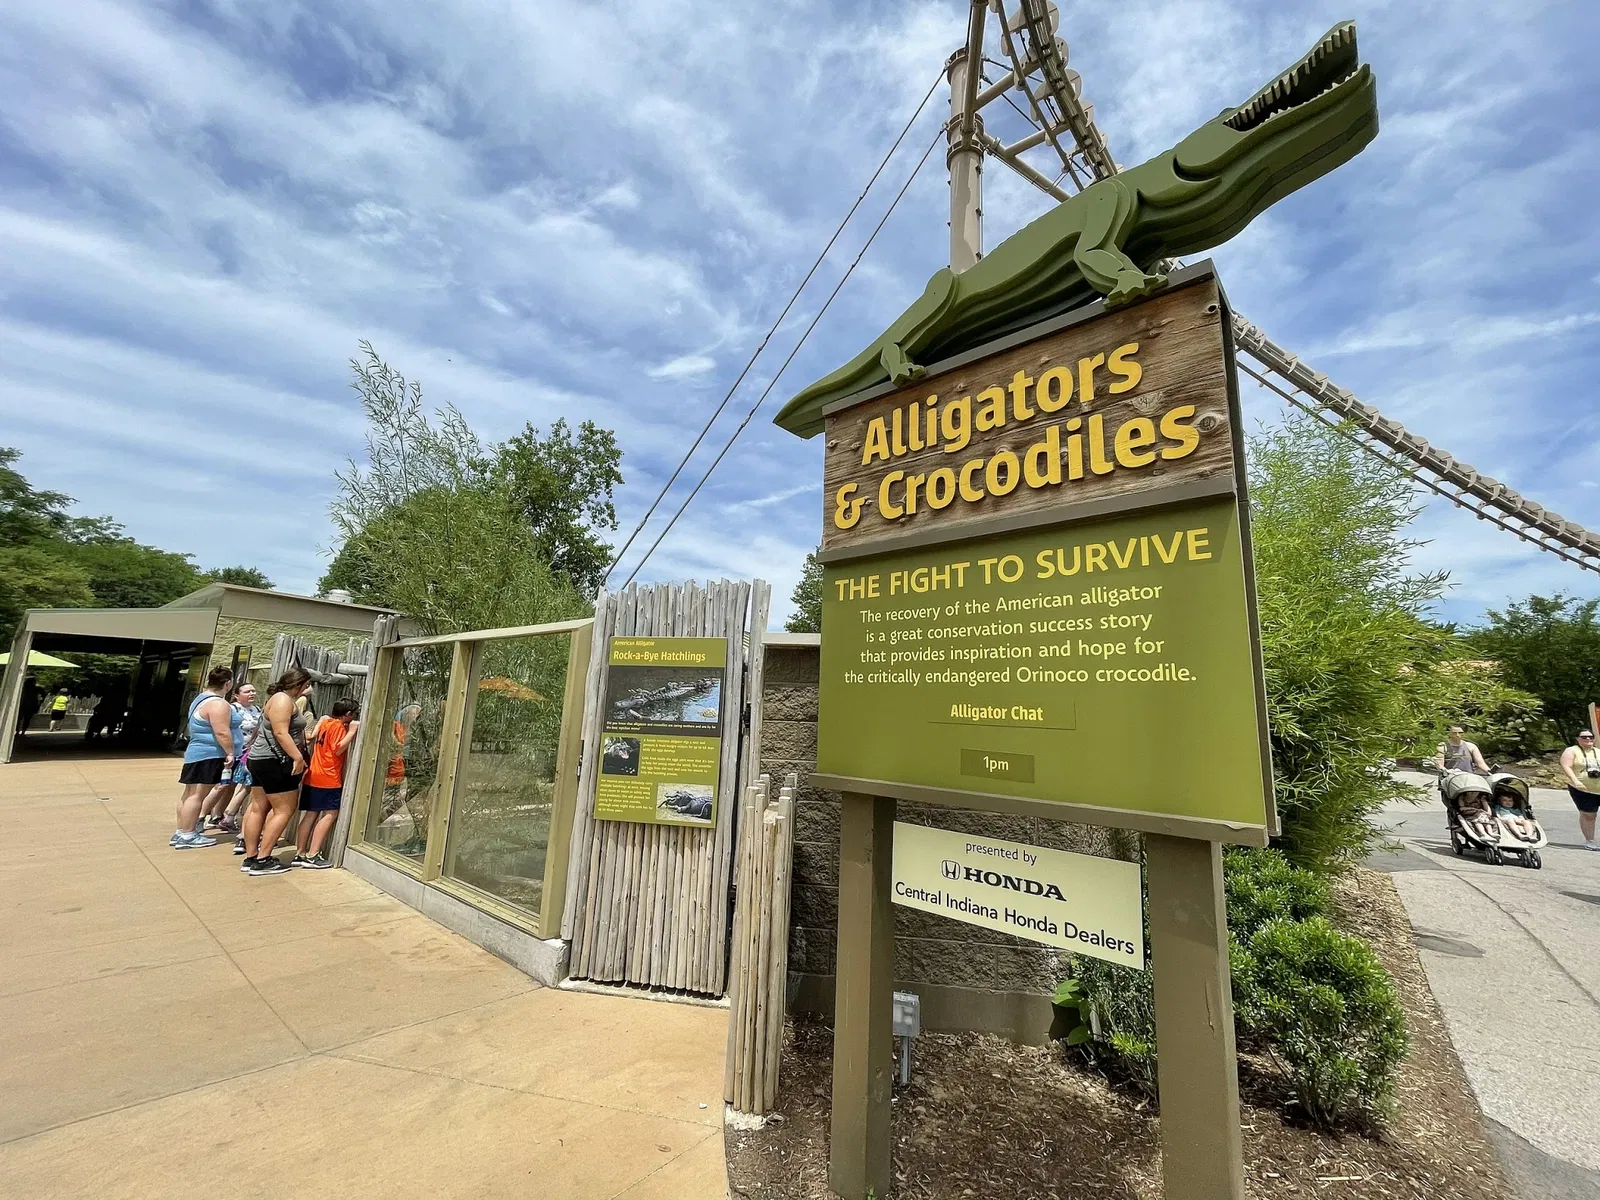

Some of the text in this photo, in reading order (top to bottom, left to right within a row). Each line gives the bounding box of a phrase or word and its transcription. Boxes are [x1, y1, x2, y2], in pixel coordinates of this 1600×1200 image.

[862, 342, 1143, 465] Alligators
[834, 405, 1200, 529] & Crocodiles
[835, 528, 1212, 601] THE FIGHT TO SURVIVE
[860, 584, 1163, 624] The recovery of the American alligator
[866, 612, 1153, 643] is a great conservation success story
[614, 651, 706, 662] Rock-a-Bye Hatchlings
[860, 636, 1165, 665] that provides inspiration and hope for
[845, 663, 1197, 686] the critically endangered Orinoco crocodile.
[951, 705, 1043, 721] Alligator Chat
[983, 755, 1009, 772] 1pm
[966, 841, 1037, 866] presented by
[964, 867, 1067, 902] HONDA
[896, 882, 1135, 955] Central Indiana Honda Dealers
